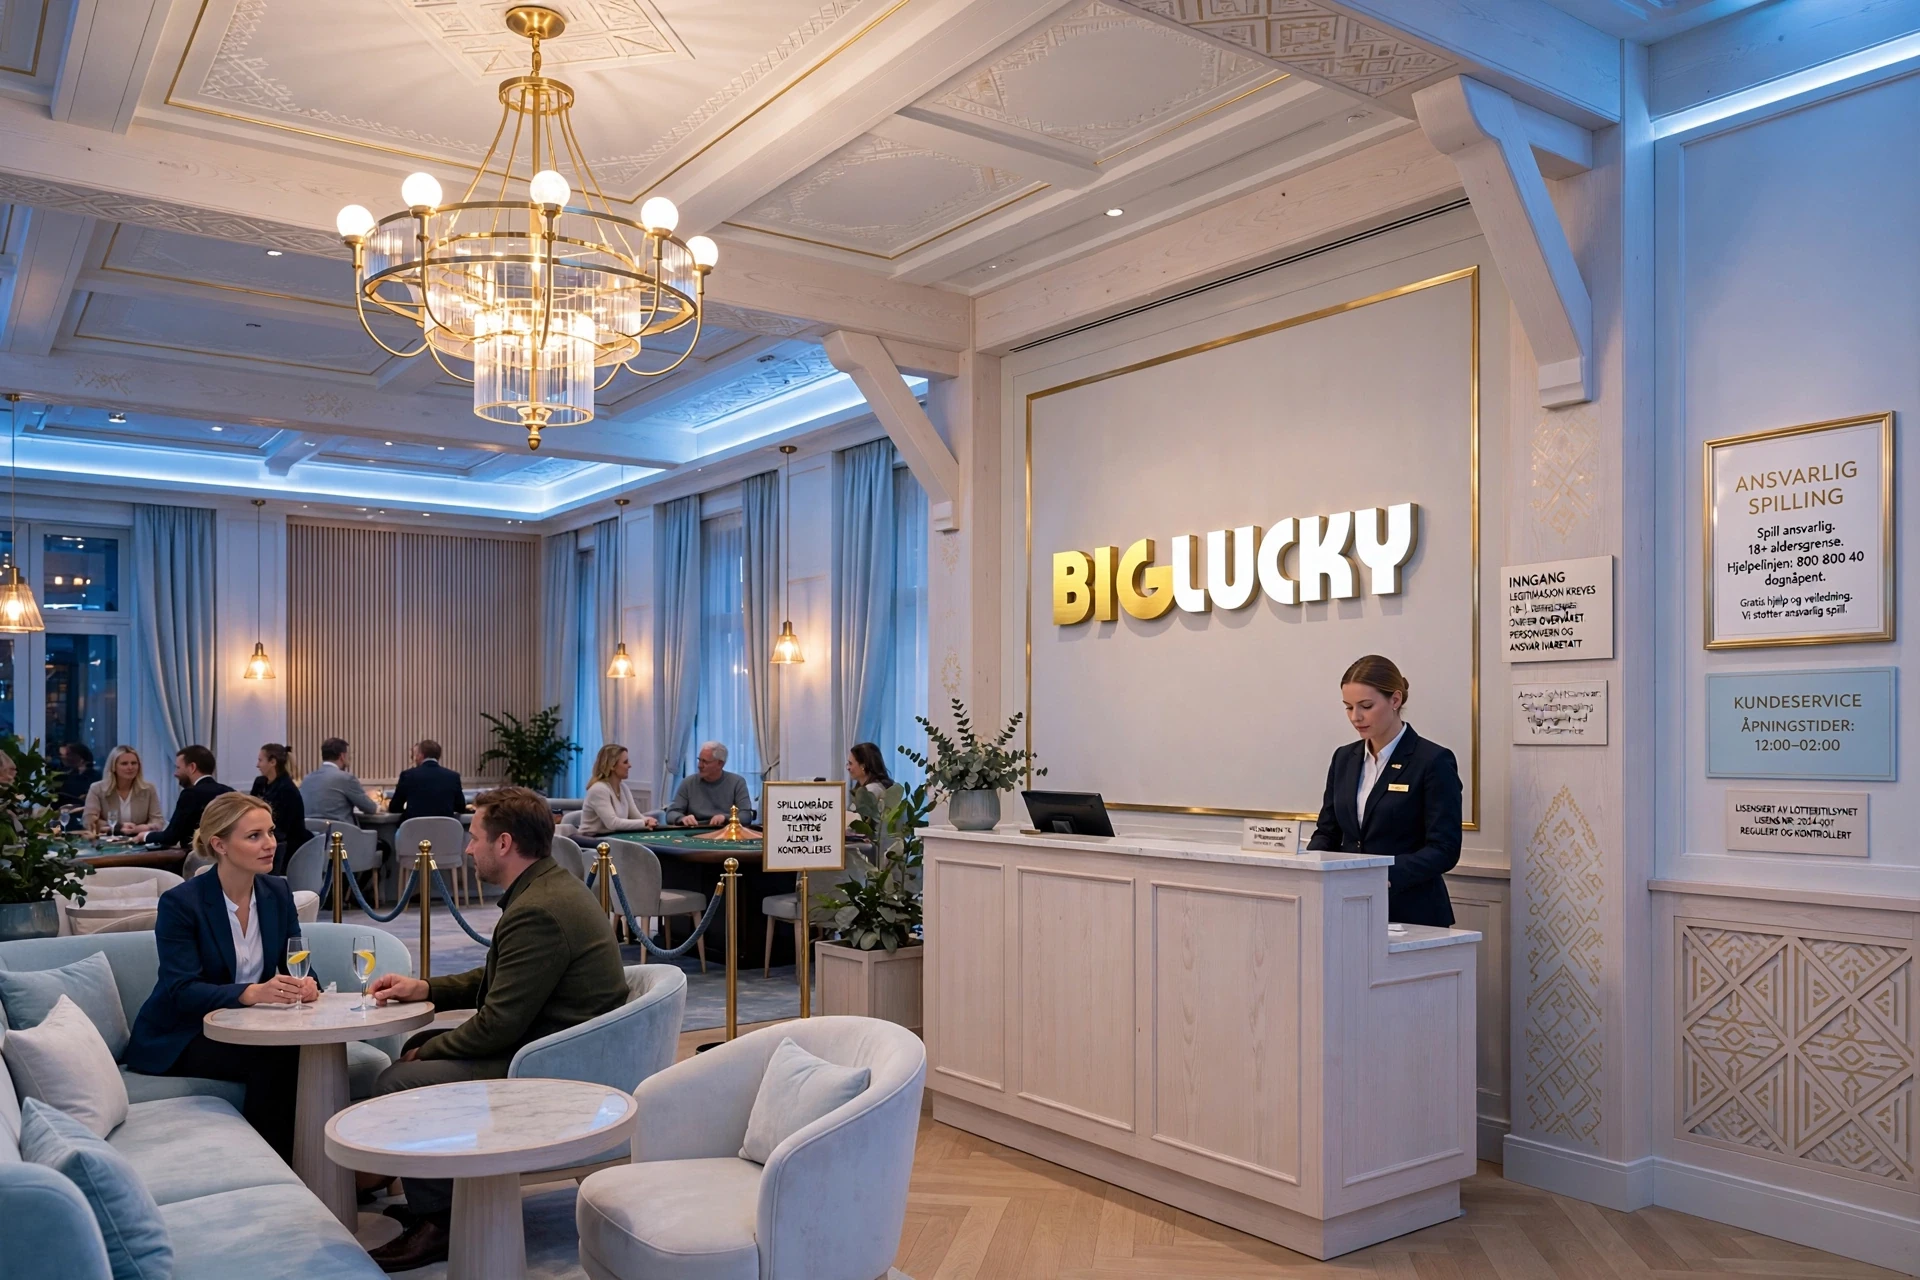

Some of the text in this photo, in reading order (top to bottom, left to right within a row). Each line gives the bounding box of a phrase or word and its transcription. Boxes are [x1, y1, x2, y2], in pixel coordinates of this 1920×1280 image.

[1736, 461, 1857, 492] ANSVARLIG
[1749, 488, 1843, 514] SPILLING
[1758, 521, 1835, 541] Spill ansvarlig.
[1749, 538, 1844, 555] 18+ aldersgrense.
[1727, 551, 1864, 575] Hjelpelinjen: 800 800 40
[1509, 572, 1565, 588] INNGANG
[1765, 572, 1826, 587] dognåpent.
[1566, 585, 1596, 595] KREVES
[1791, 596, 1801, 606] og
[1805, 591, 1853, 603] veiledning.
[1742, 611, 1750, 620] Vi
[1785, 606, 1823, 618] ansvarlig
[1826, 604, 1847, 616] spill.
[1561, 627, 1573, 636] OG
[1510, 642, 1539, 651] ANSVAR
[1734, 694, 1862, 709] KUNDESERVICE
[1741, 717, 1854, 732] ÅPNINGSTIDER:
[777, 798, 833, 809] SPILLOMRÅDE
[1777, 805, 1788, 814] AV
[1740, 827, 1778, 836] REGULERT
[1780, 828, 1793, 837] OG
